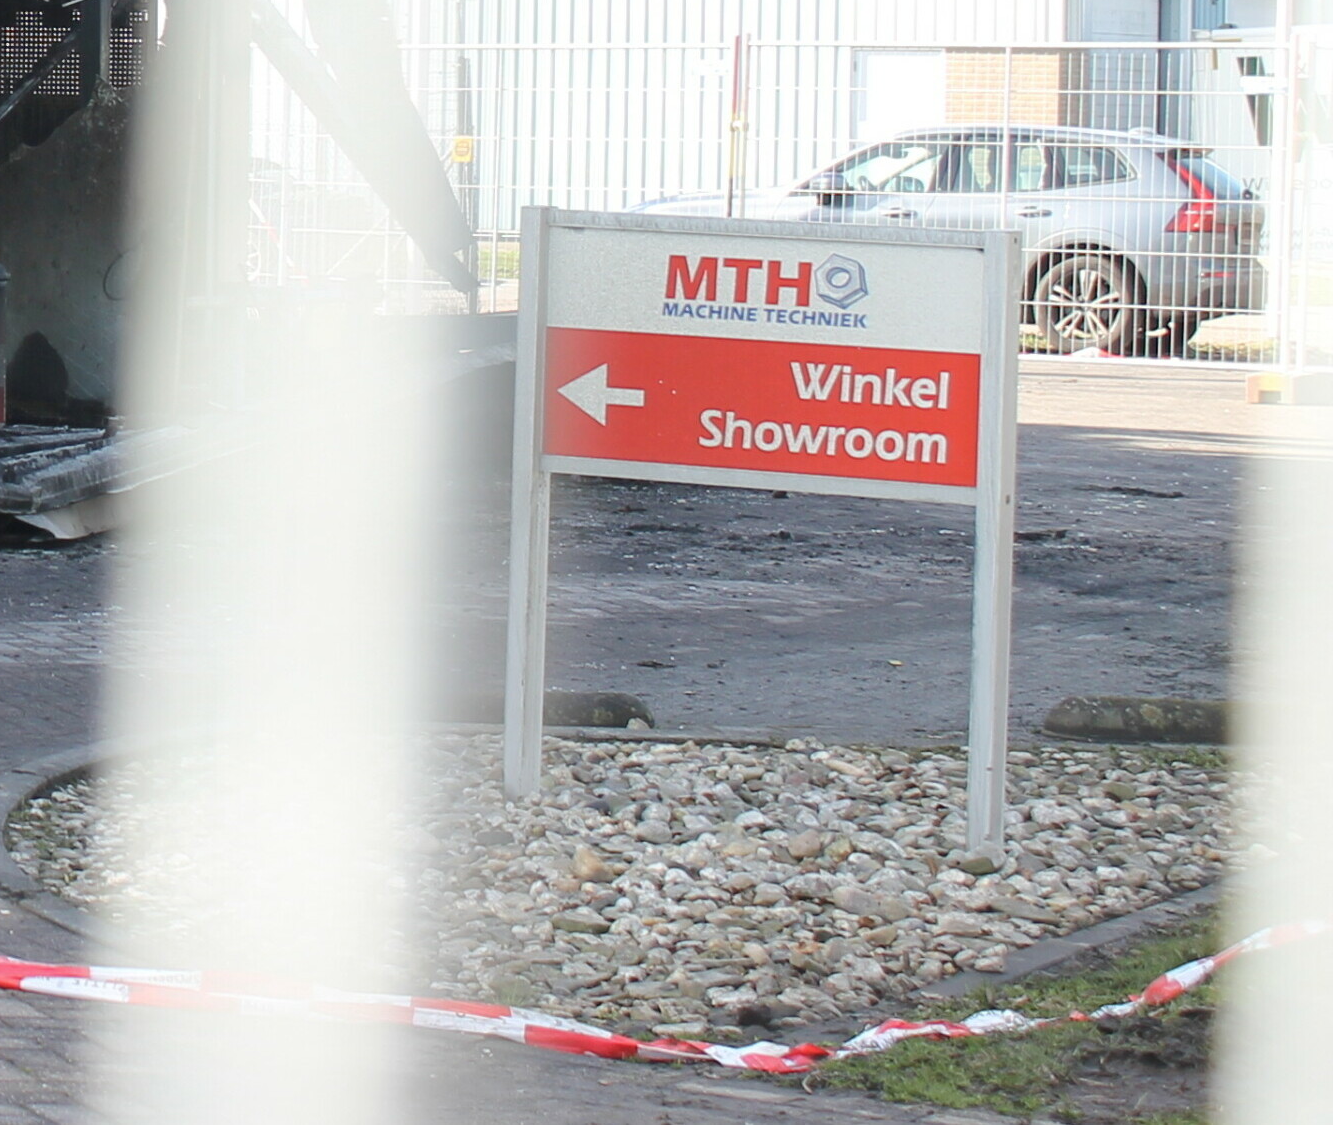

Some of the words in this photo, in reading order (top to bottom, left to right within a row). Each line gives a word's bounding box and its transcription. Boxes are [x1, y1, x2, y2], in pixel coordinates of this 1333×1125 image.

[665, 254, 813, 307] MTH
[661, 301, 758, 323] MACHINE
[763, 307, 868, 329] TECHNIEK
[789, 361, 951, 410] Winkel
[697, 408, 948, 465] Showroom
